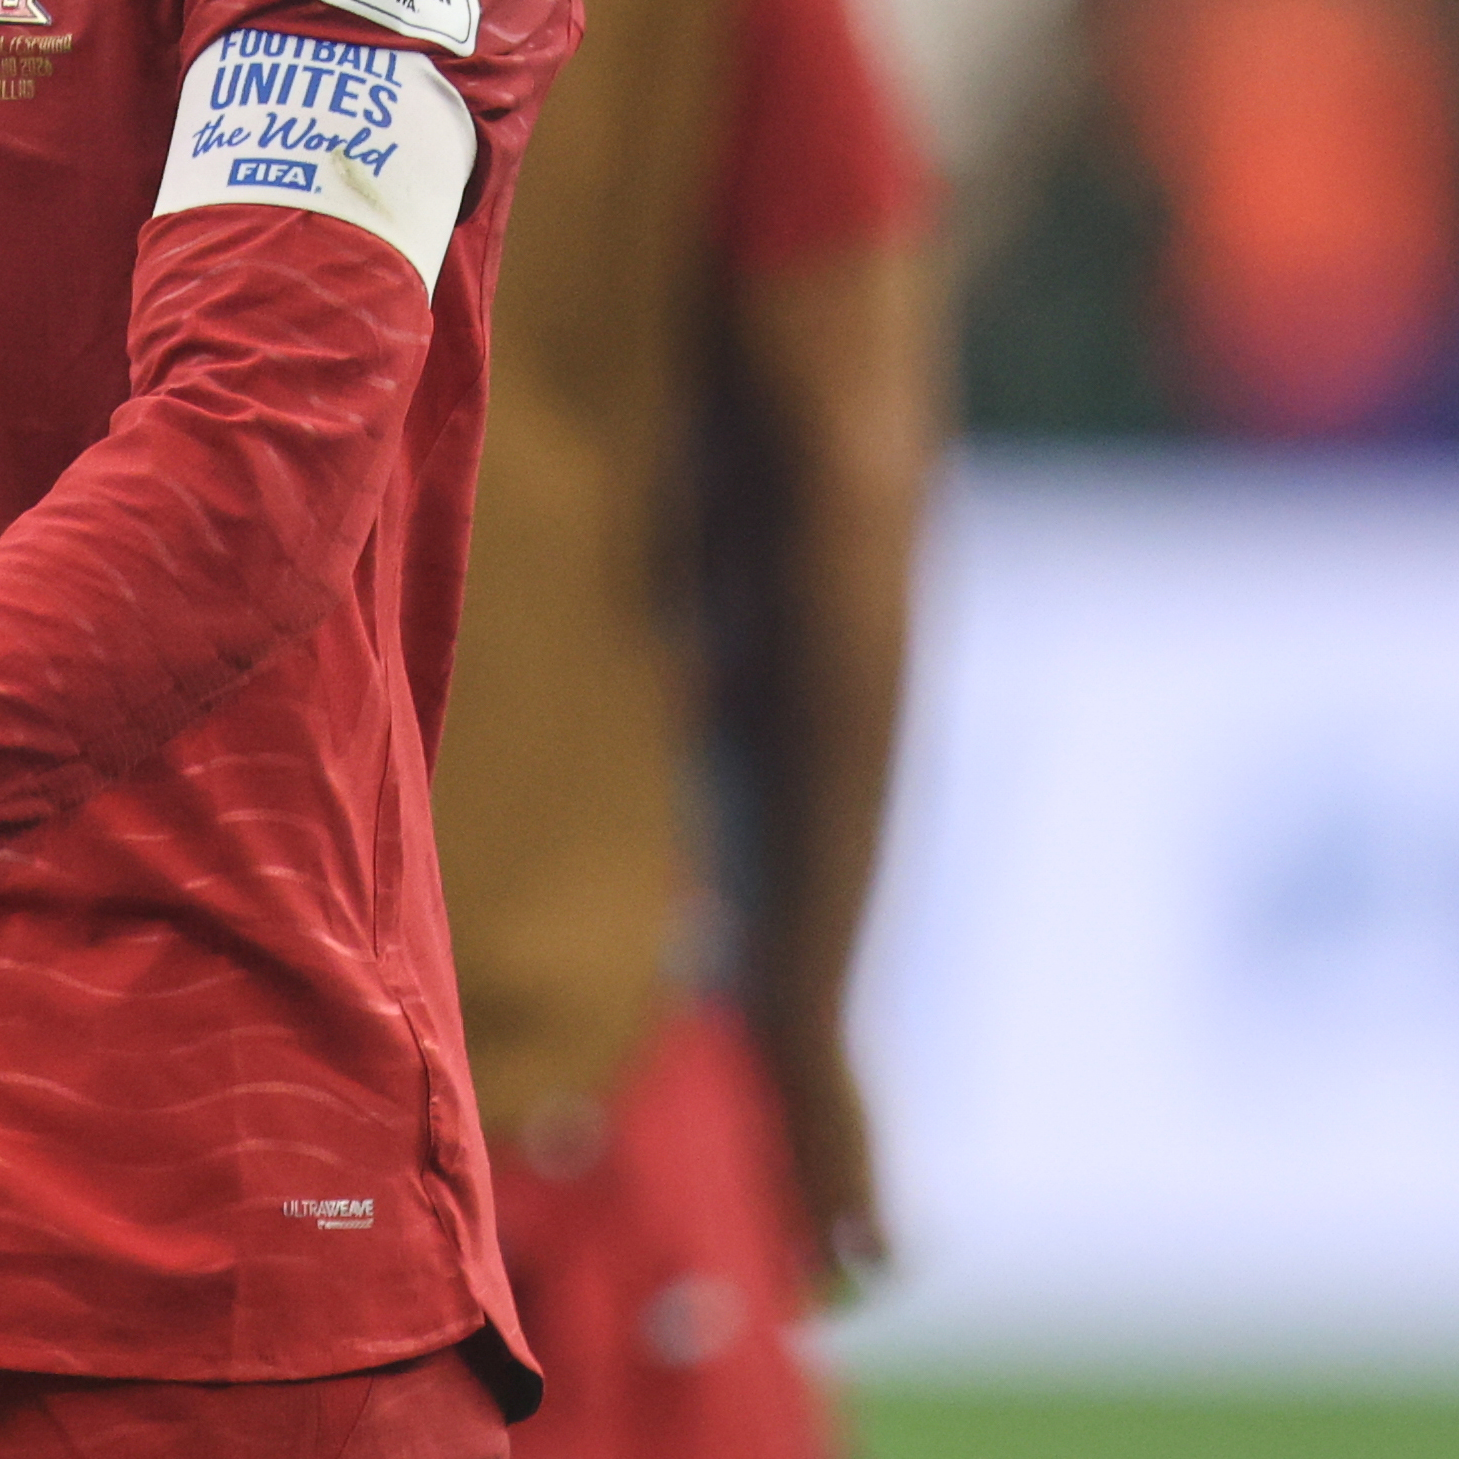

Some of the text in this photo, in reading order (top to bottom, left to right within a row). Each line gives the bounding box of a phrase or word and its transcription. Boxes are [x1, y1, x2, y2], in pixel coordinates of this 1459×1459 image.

[218, 28, 403, 88] FOOTBALL
[209, 62, 398, 130] UNITES
[191, 111, 398, 178] the World
[234, 161, 308, 188] FIFA
